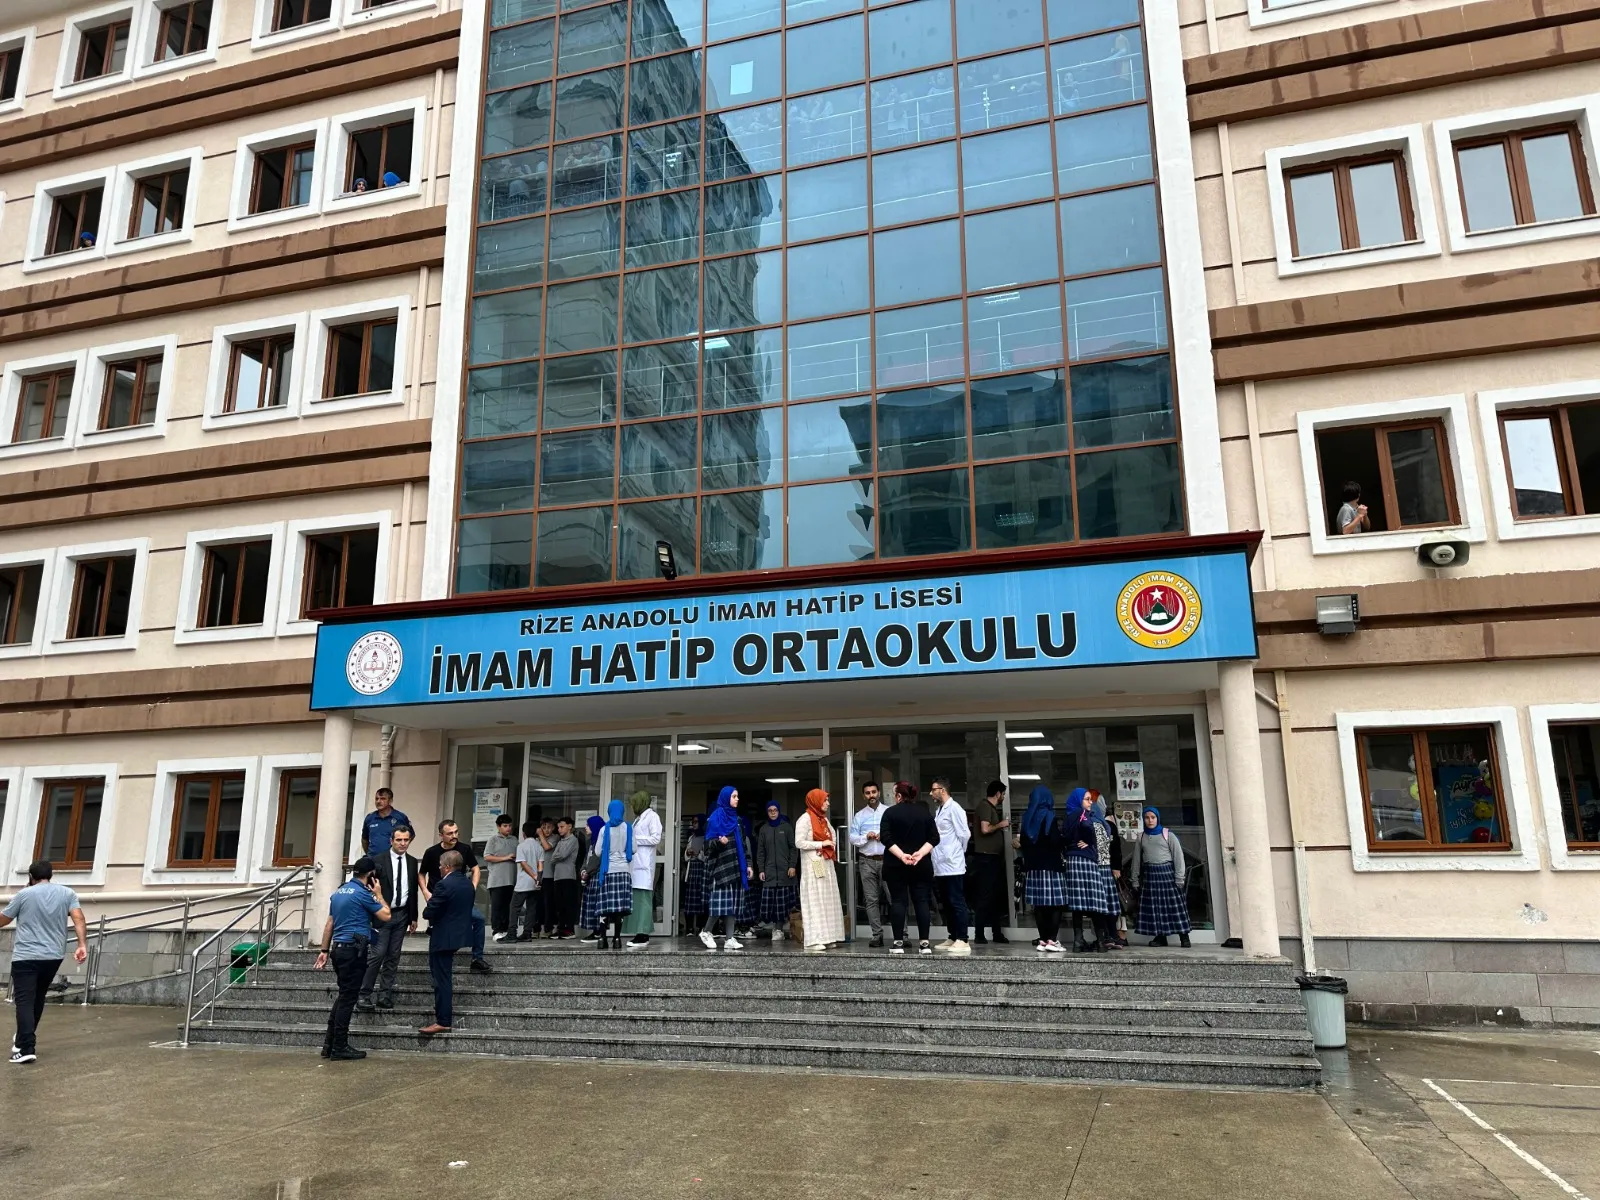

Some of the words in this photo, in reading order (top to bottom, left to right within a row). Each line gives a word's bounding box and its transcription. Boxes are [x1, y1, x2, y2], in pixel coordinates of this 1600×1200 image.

[1147, 574, 1175, 584] İMAM
[1175, 580, 1197, 604] HATİP
[520, 613, 574, 636] RİZE
[580, 606, 699, 632] ANADOLU
[708, 600, 776, 622] İMAM
[786, 590, 864, 617] HATİP
[874, 582, 962, 611] LİSESİ
[1120, 578, 1145, 617] ANADOLU
[1122, 618, 1140, 638] RİZE
[1182, 607, 1198, 634] LİSESİ
[428, 645, 553, 695] İMAM
[569, 629, 715, 686] HATİP
[732, 611, 1078, 676] ORTAOKULU
